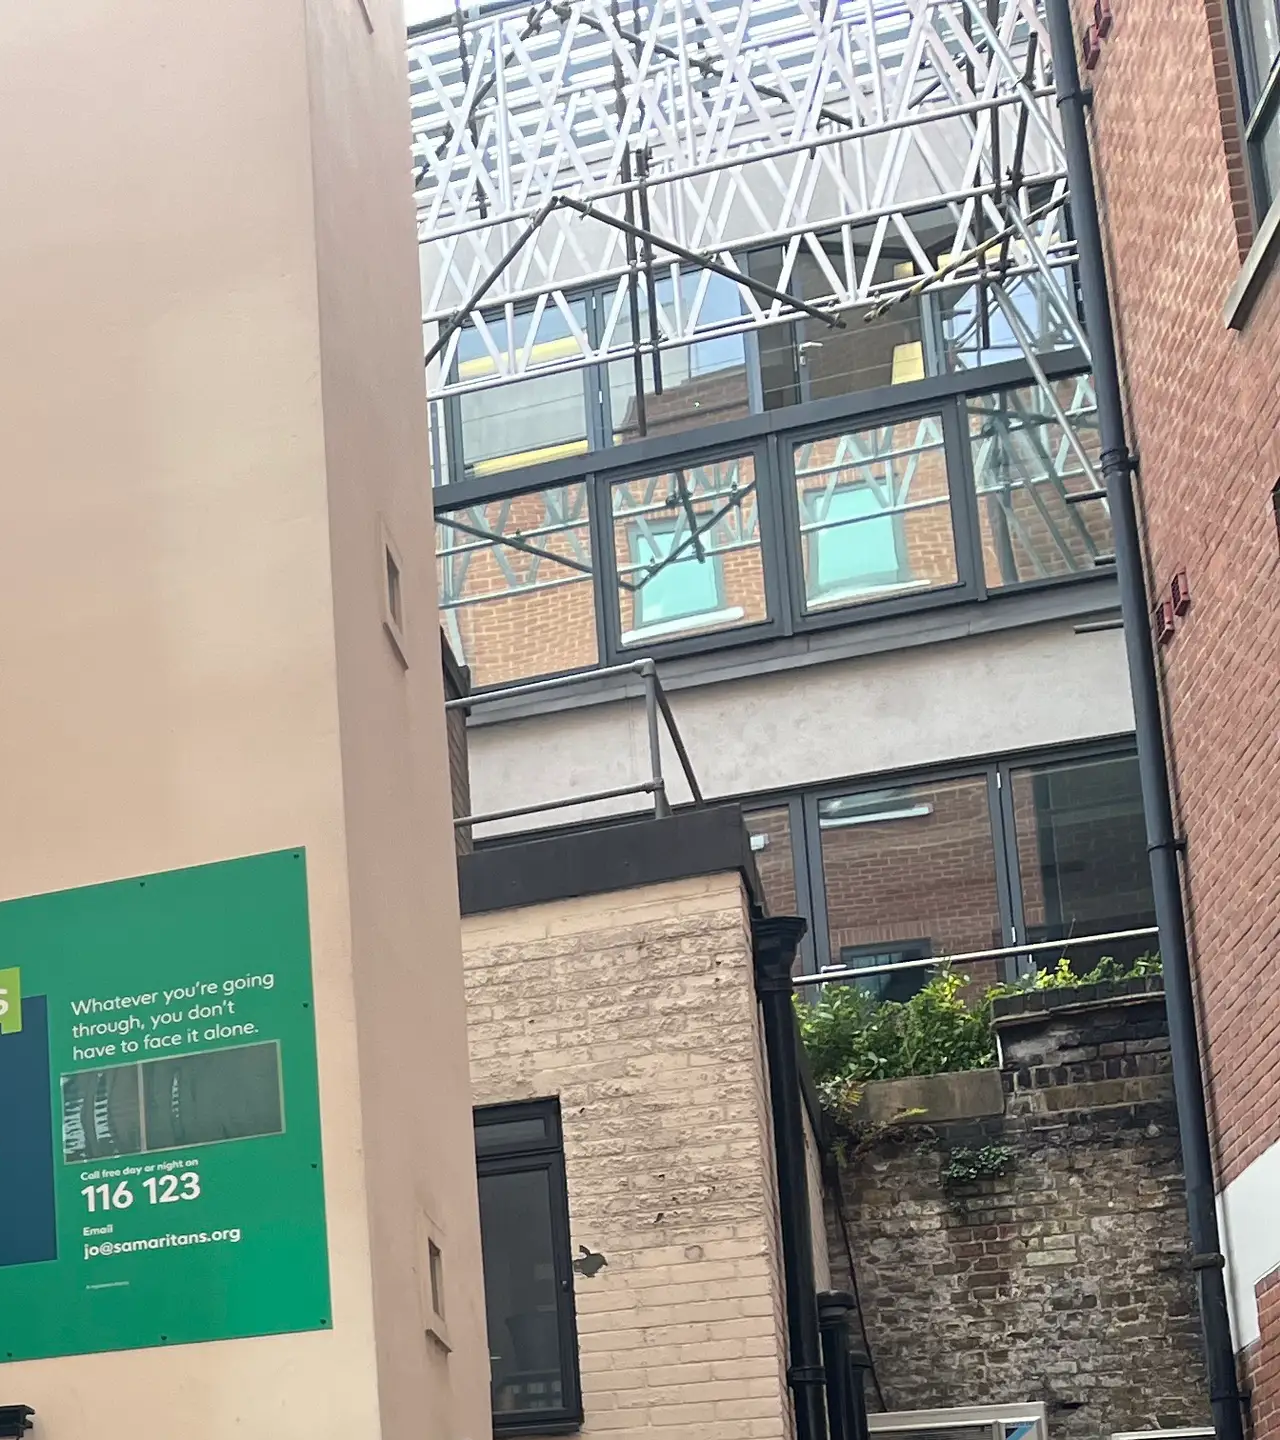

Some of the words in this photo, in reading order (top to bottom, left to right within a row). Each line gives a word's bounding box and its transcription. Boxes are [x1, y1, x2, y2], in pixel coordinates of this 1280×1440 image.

[70, 991, 158, 1016] Whatever
[162, 981, 218, 1007] you're
[222, 972, 275, 995] going
[71, 1015, 145, 1039] through,
[150, 1009, 183, 1030] you
[187, 1000, 235, 1020] don't
[72, 1043, 117, 1060] have
[120, 1037, 139, 1053] to
[143, 1032, 182, 1050] face
[186, 1027, 200, 1044] it
[203, 1021, 259, 1042] alone.
[80, 1170, 100, 1181] Call
[102, 1167, 121, 1178] free
[122, 1164, 143, 1177] day
[144, 1163, 156, 1172] or
[156, 1159, 184, 1172] night
[185, 1158, 199, 1167] on
[80, 1180, 134, 1213] 116
[142, 1171, 201, 1204] 123
[83, 1224, 114, 1237] Email
[83, 1227, 241, 1260] jo@samaritans.org
